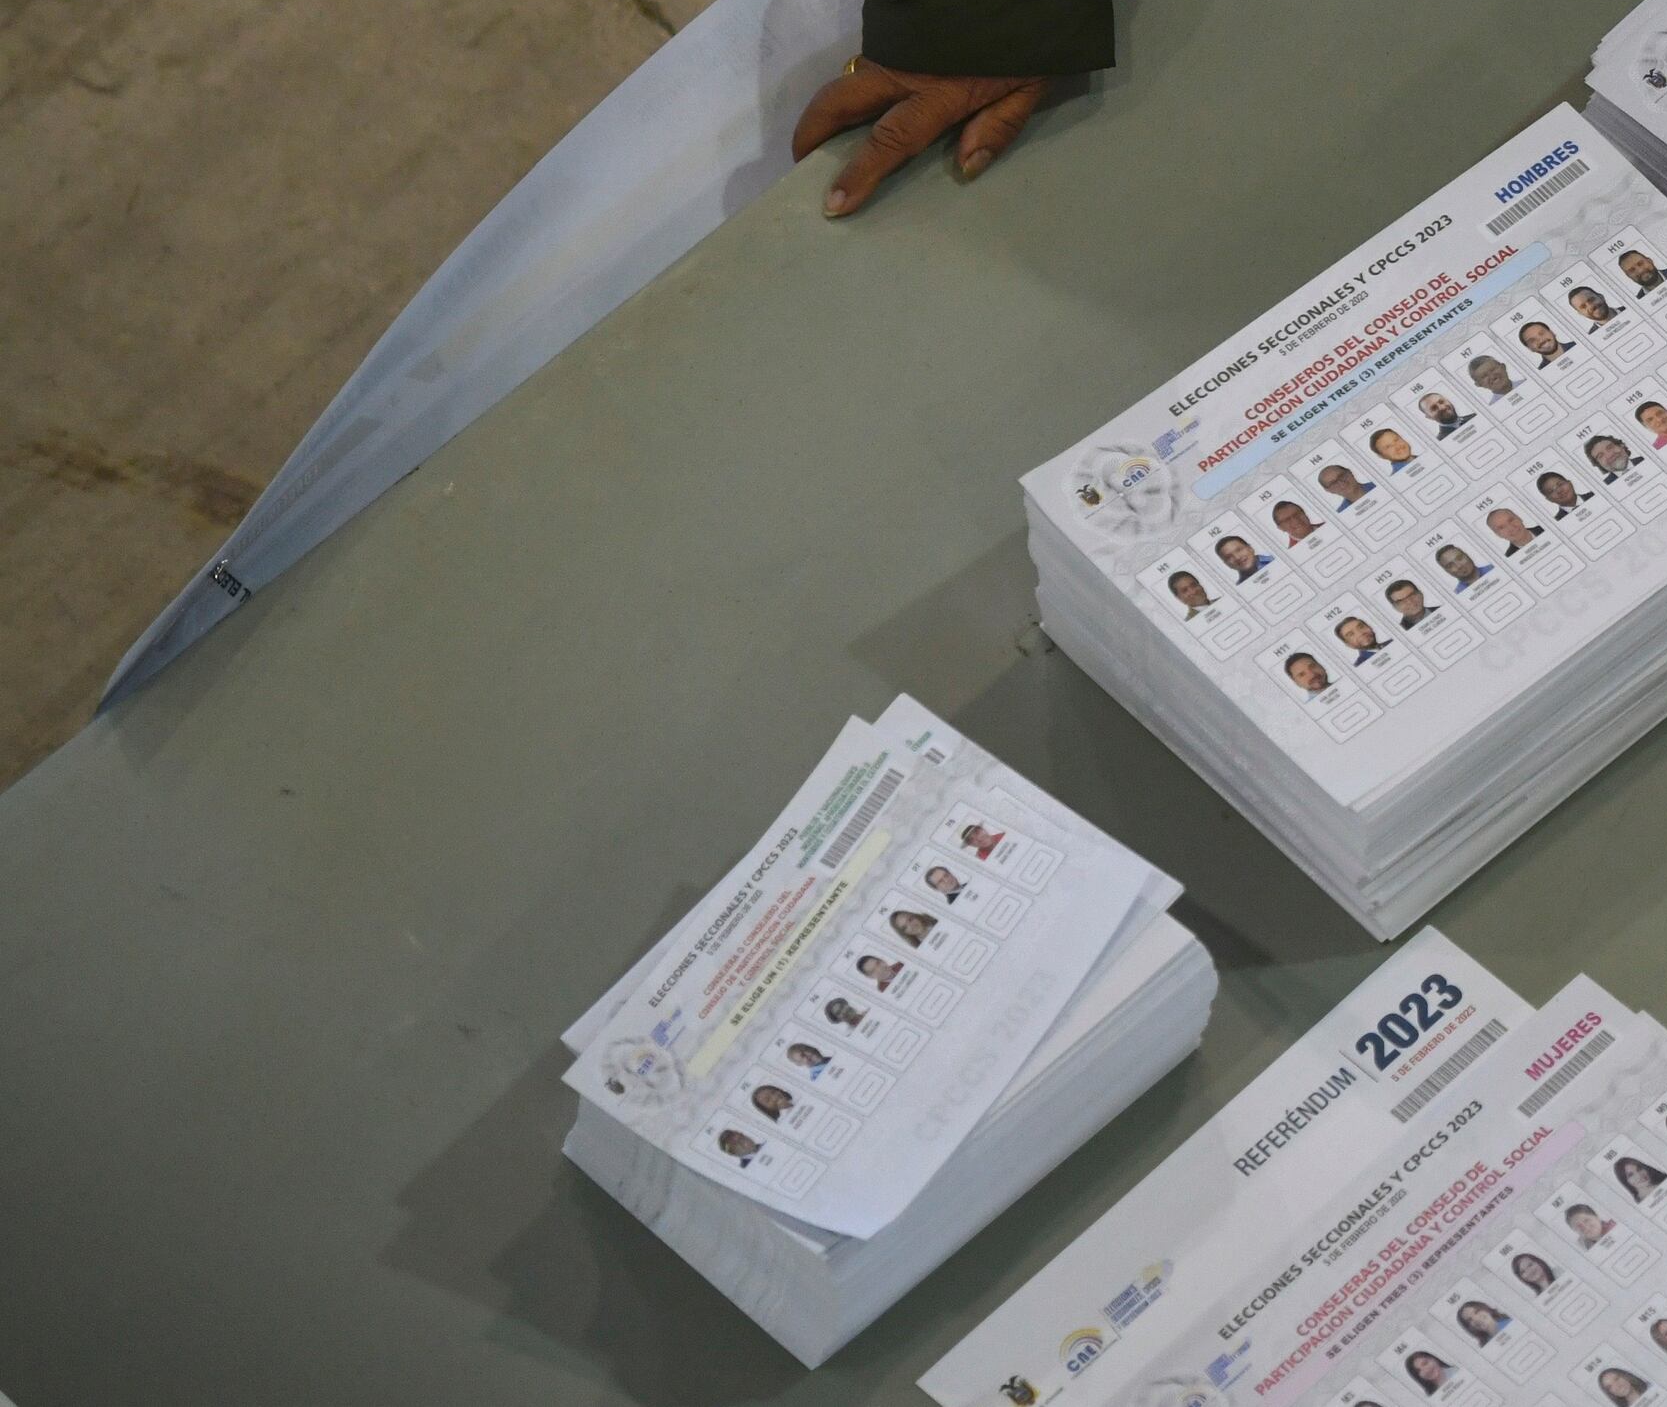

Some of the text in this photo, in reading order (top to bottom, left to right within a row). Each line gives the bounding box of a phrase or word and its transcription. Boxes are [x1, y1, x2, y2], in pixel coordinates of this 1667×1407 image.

[1494, 140, 1579, 203] HOMBRES
[1607, 239, 1624, 253] H10
[1168, 214, 1452, 416] ELECCIONES SECCIONALES Y CPCCS 2023
[1197, 394, 1304, 472] PARTICIPACION
[1303, 335, 1390, 397] CIUDADANA
[1385, 324, 1399, 336] Y
[1400, 281, 1468, 328] CONTROL
[1465, 244, 1519, 283] SOCIAL
[1244, 272, 1451, 420] CONSEJEROS DEL CONSEJO DE
[1270, 298, 1473, 442] SE ELIGEN TRES (3) REPRESENTANTES
[1575, 425, 1592, 439] H17
[1258, 490, 1272, 501] H3
[1156, 562, 1170, 573] H1
[1374, 569, 1392, 584] H13
[648, 827, 798, 1008] ELECCIONES SECCIONALES Y CPCCS 2023
[1233, 973, 1463, 1176] REFERÉNDUM 2023
[1524, 1011, 1602, 1081] MUJERES
[1218, 1264, 1302, 1340] ELECCIONES
[1300, 1181, 1392, 1266] SECCIONALES
[1389, 1169, 1403, 1182] Y
[1403, 1130, 1449, 1172] CPCCS
[1446, 1099, 1482, 1133] 2023
